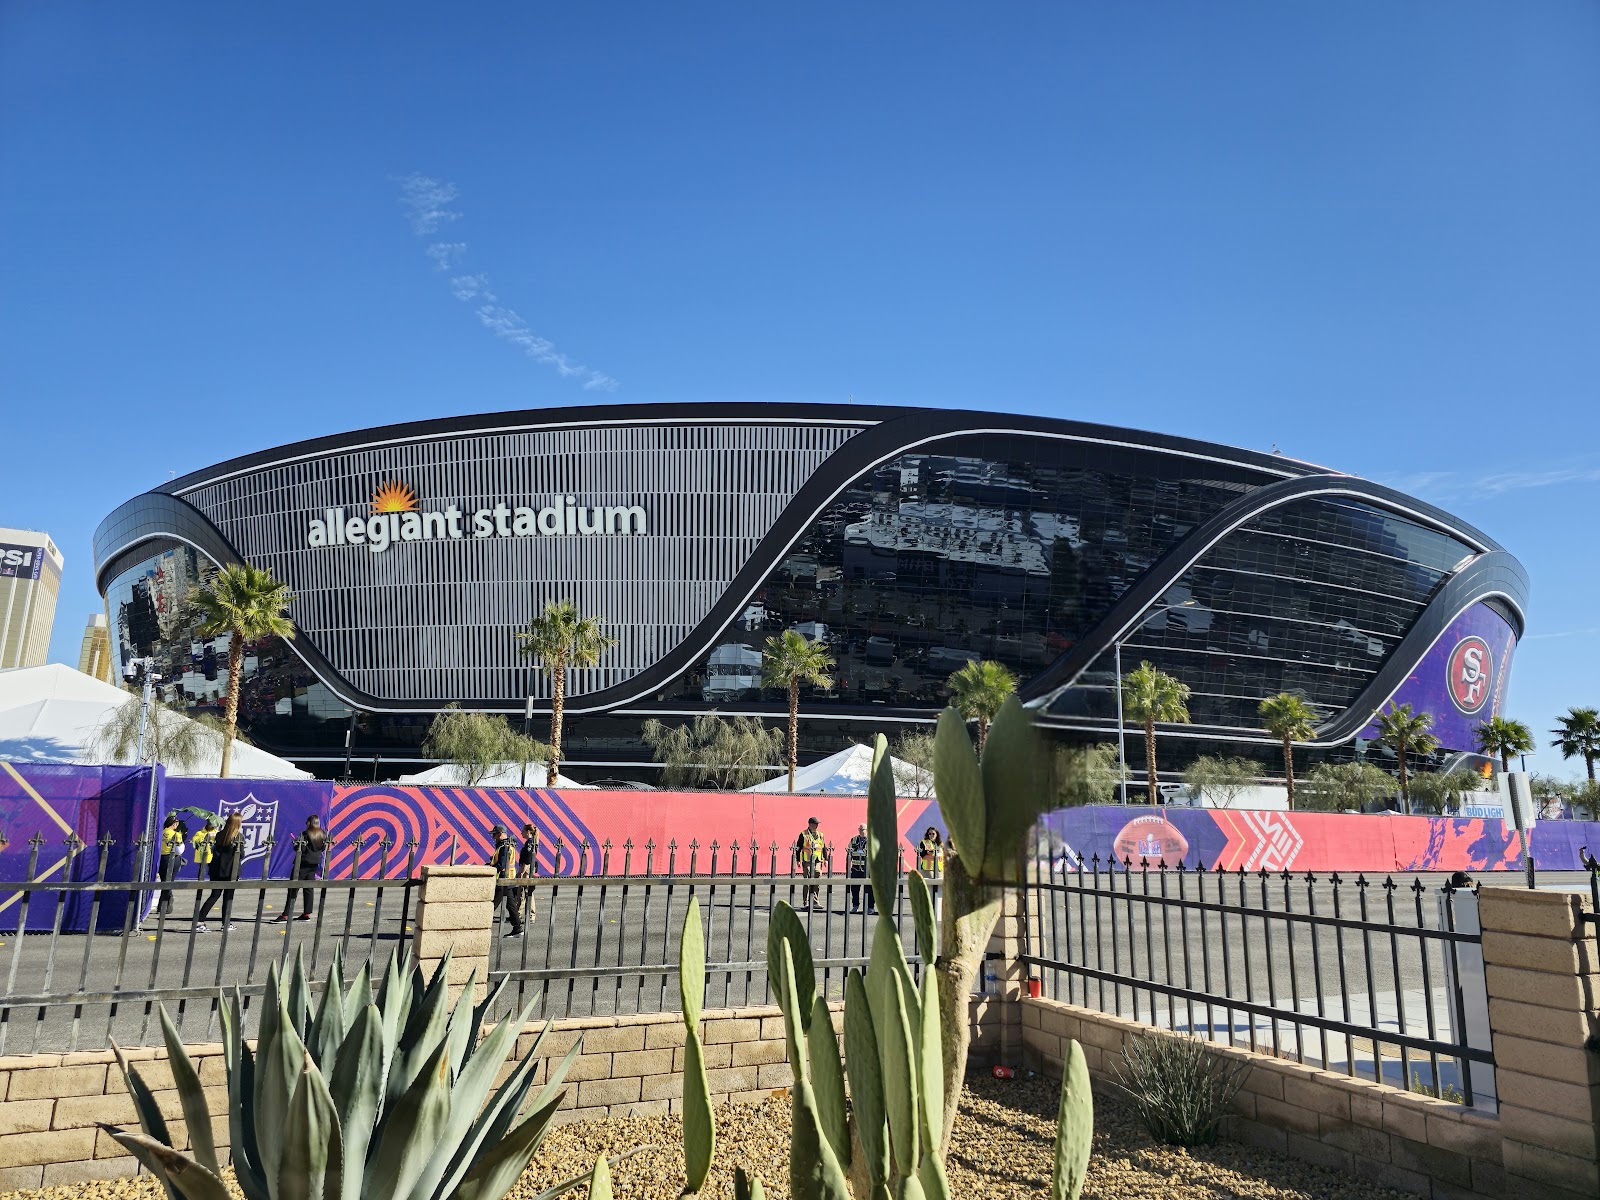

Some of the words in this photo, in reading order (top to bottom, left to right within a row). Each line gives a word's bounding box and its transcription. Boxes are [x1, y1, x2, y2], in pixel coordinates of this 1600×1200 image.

[307, 505, 463, 552] allegiant
[474, 494, 647, 538] stadium
[1466, 807, 1483, 817] BUD
[241, 825, 267, 850] FL
